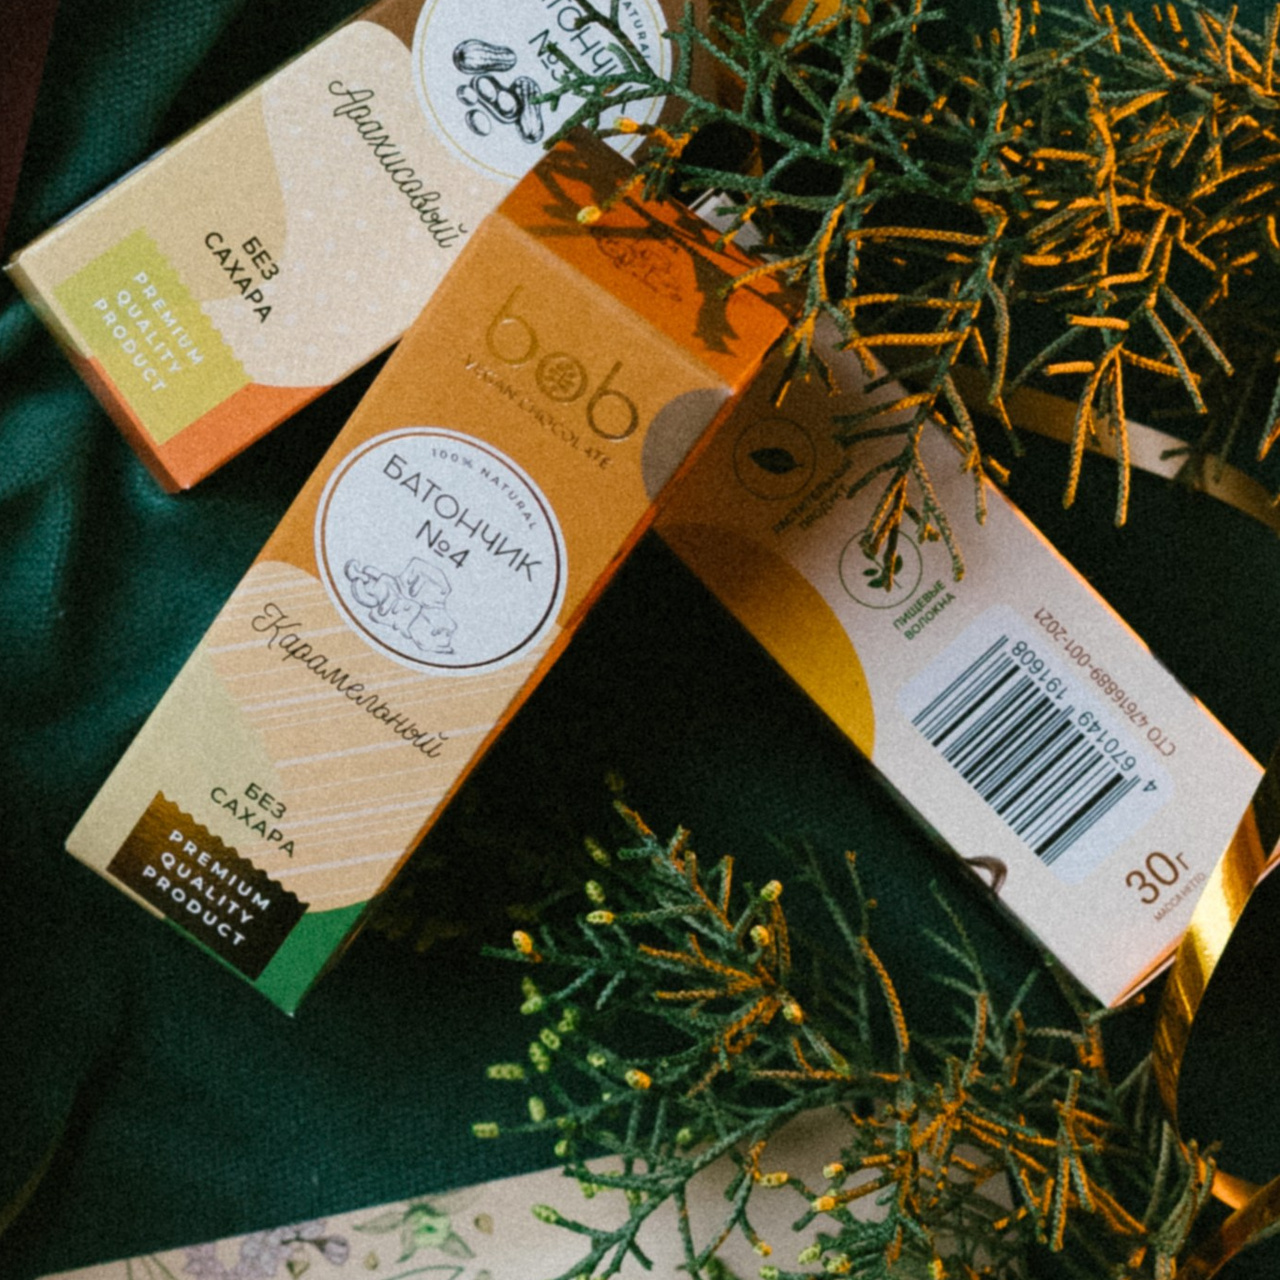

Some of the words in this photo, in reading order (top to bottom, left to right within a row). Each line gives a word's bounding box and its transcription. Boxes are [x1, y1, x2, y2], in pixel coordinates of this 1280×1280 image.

[328, 78, 469, 249] Арахисовый
[203, 231, 274, 324] САХАРА
[241, 235, 281, 282] БЕЗ
[92, 297, 168, 394] PRODUCT
[116, 289, 183, 375] QUALITY
[132, 270, 205, 366] PREMIUM
[485, 284, 640, 441] bob
[382, 453, 542, 582] БАТОНЧИК
[431, 447, 474, 468] 100%
[479, 466, 538, 531] NATURAL
[415, 519, 472, 570] №4
[892, 579, 947, 631] ПИЩЕВЫЕ
[903, 591, 957, 641] ВОЛОКНА
[250, 601, 450, 759] Карамельный
[1011, 640, 1068, 701] 191608
[1077, 710, 1138, 772] 670149
[209, 786, 296, 859] САХАРА
[243, 782, 288, 820] БЕЗ
[1142, 778, 1158, 793] 4
[142, 864, 246, 947] PRODUCT
[160, 851, 255, 926] QUALITY
[168, 828, 271, 912] PREMIUM
